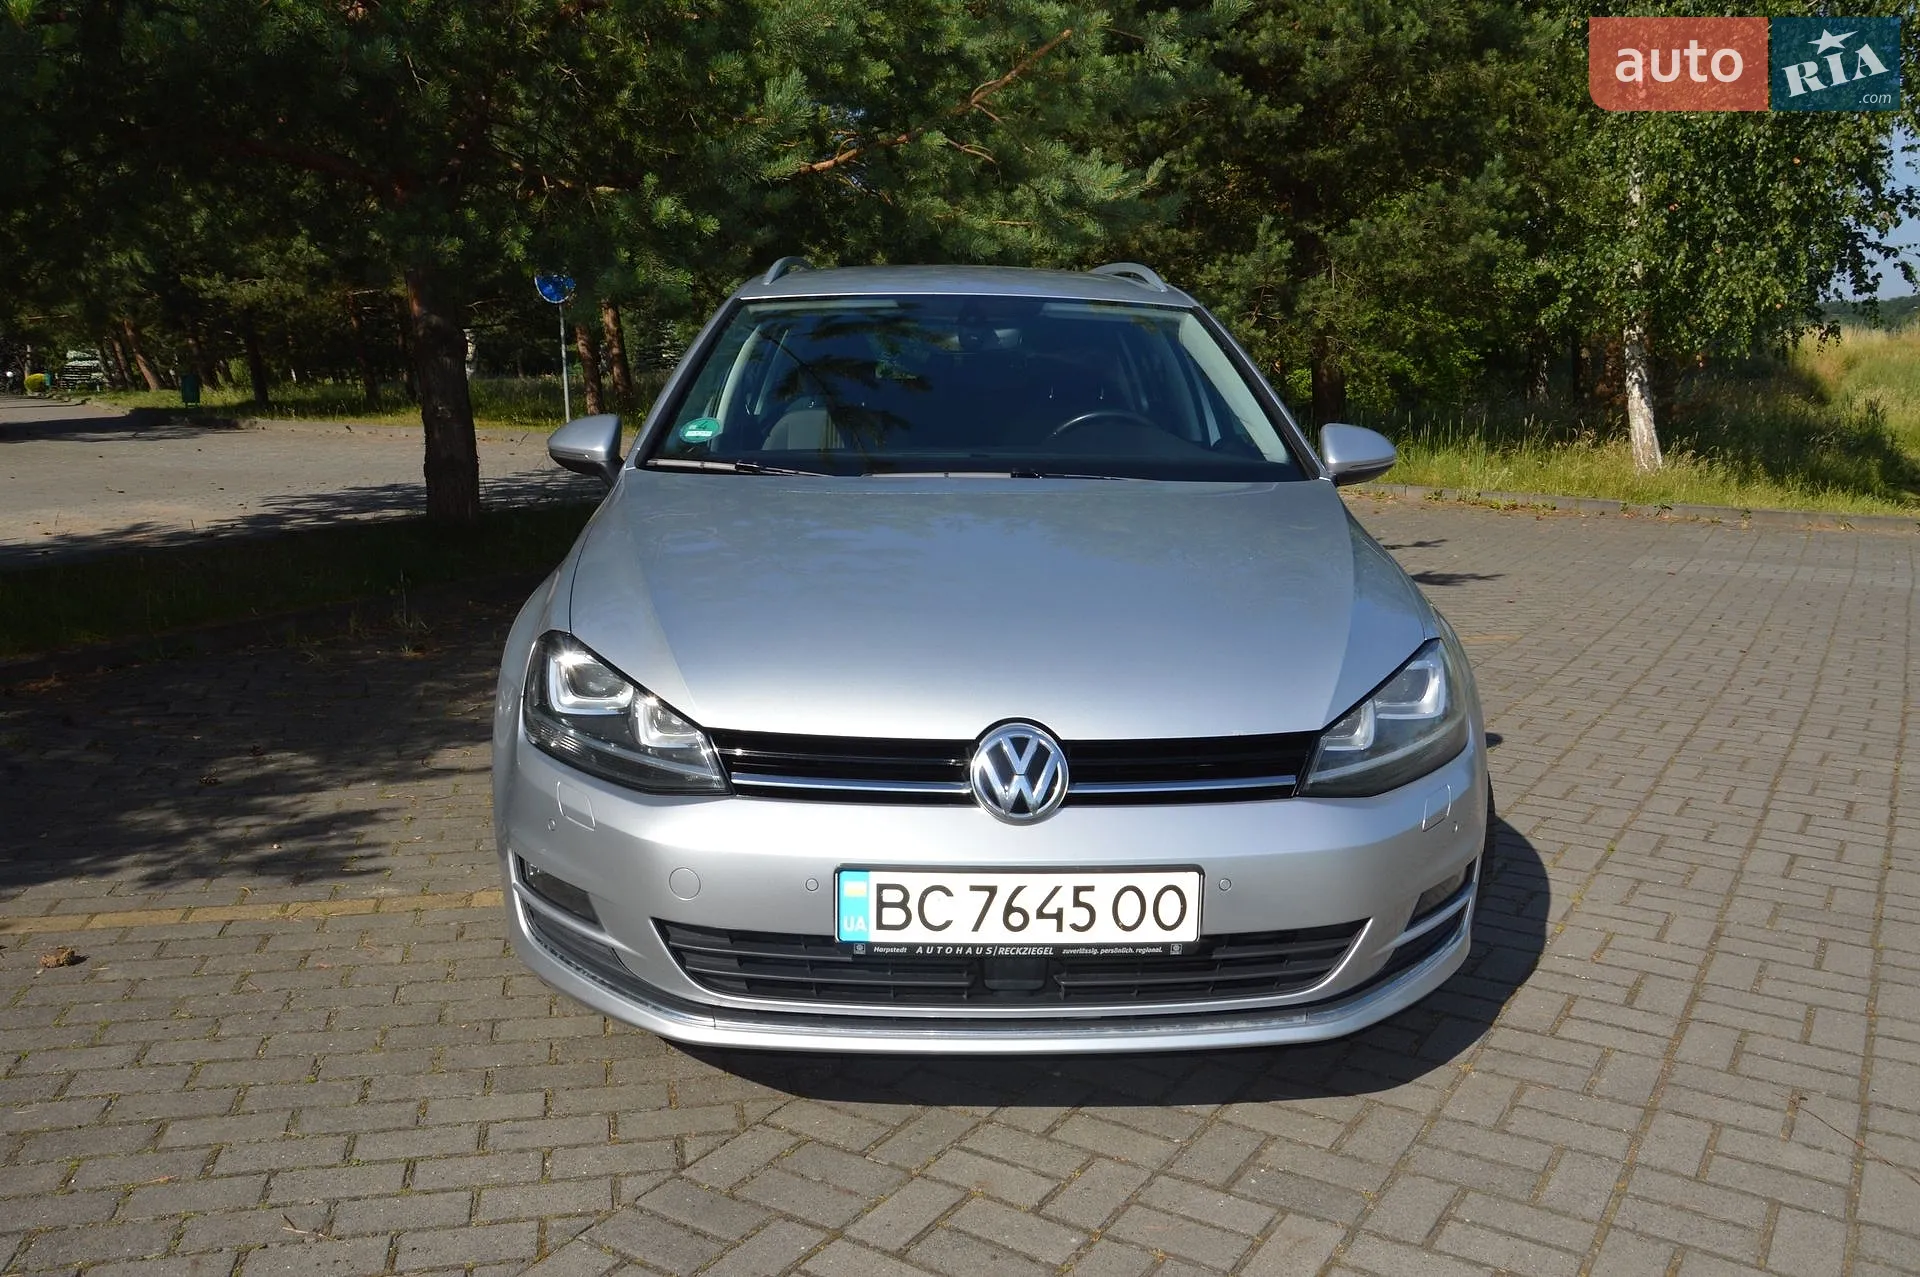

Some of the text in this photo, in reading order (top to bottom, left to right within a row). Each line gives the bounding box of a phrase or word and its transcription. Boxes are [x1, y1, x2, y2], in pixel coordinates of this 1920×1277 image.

[843, 915, 868, 932] UA
[875, 883, 954, 932] BC
[969, 885, 1097, 933] 7645
